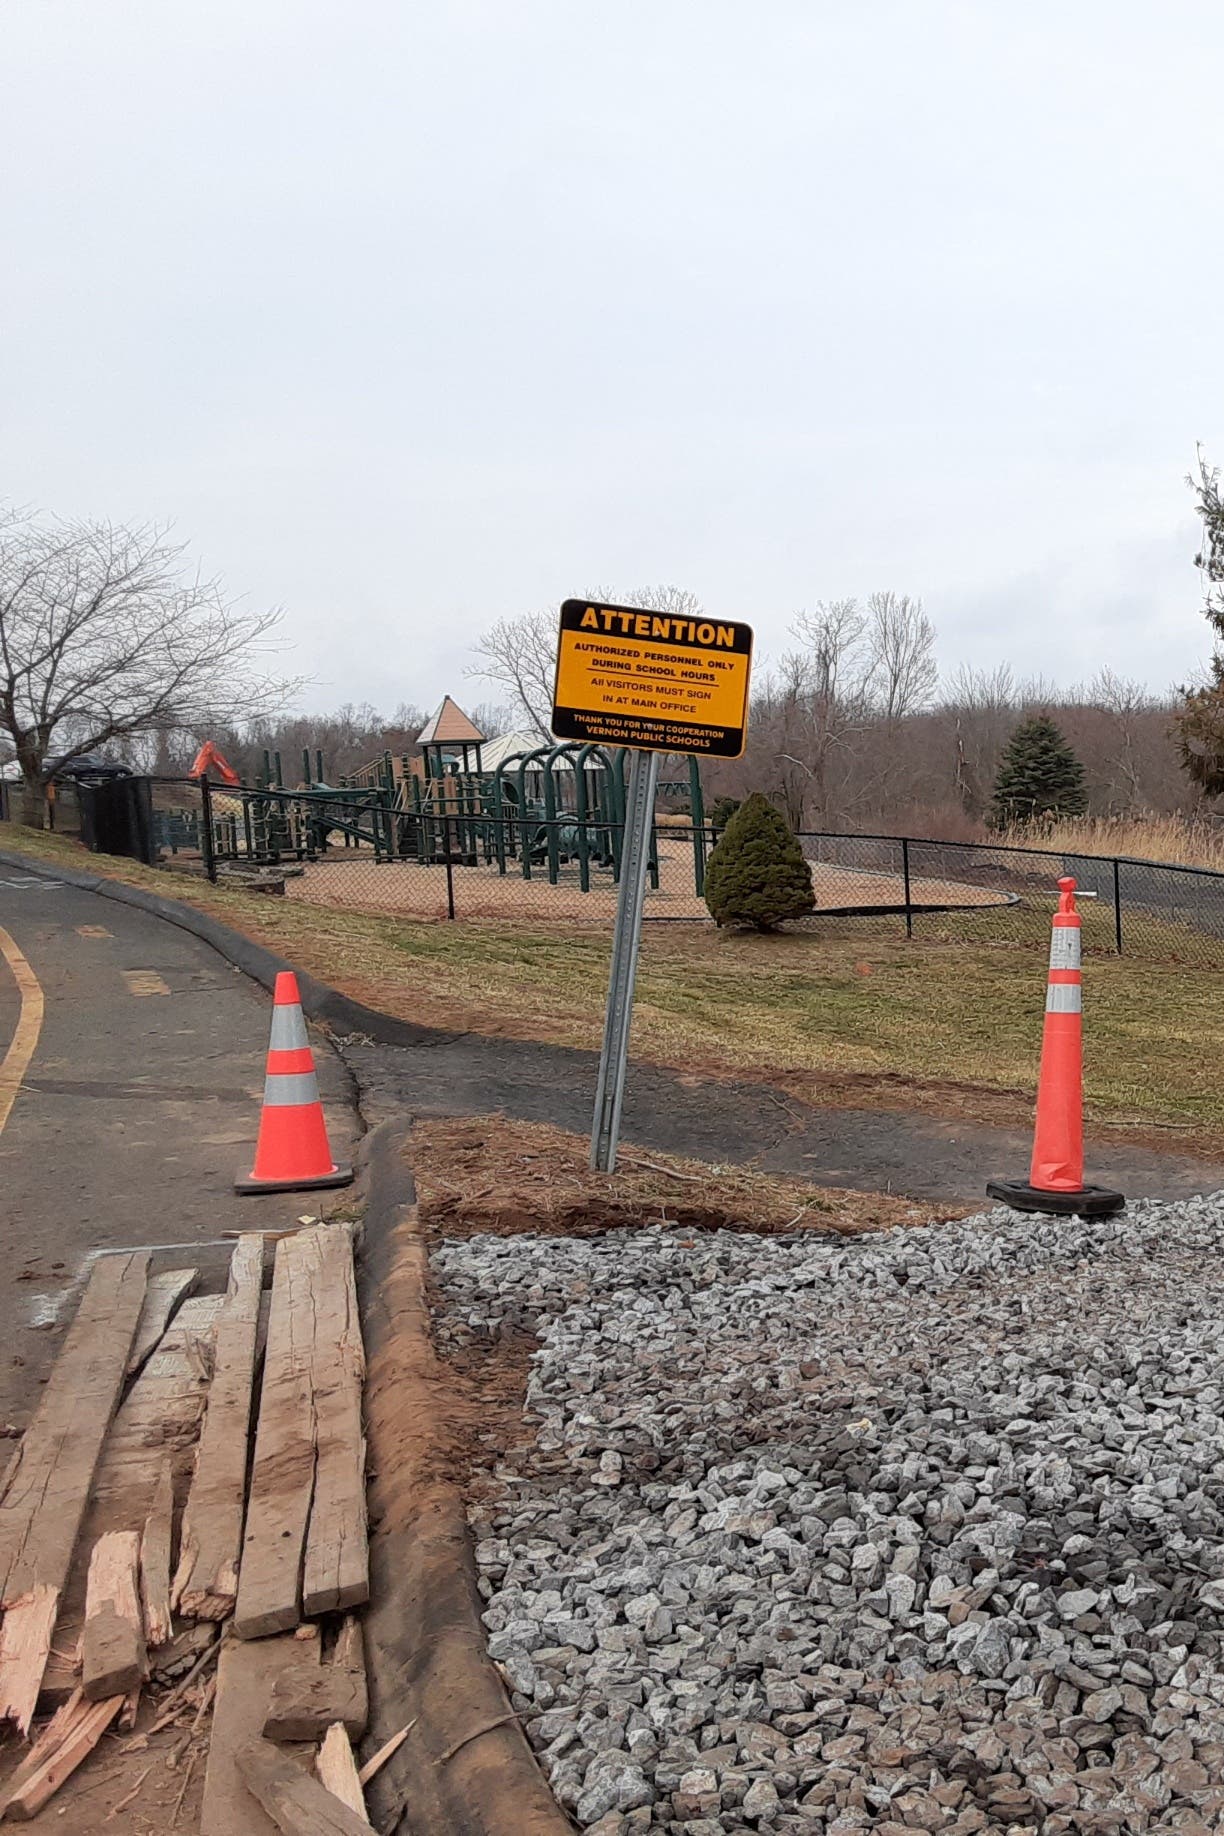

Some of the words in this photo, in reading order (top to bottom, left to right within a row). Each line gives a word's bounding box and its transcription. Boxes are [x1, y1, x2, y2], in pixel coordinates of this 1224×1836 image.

[580, 607, 735, 647] ATTENTION
[574, 642, 640, 659] AUTHORIZED
[644, 652, 704, 667] PERSONNEL
[707, 659, 735, 671] ONLY
[592, 658, 632, 671] DURING
[636, 664, 676, 677] SCHOOL
[681, 670, 716, 682] HOURS
[606, 679, 653, 693] VISITORS
[656, 686, 685, 697] MUST
[687, 690, 712, 700] SIGN
[602, 695, 614, 703] IN
[616, 696, 629, 705] AT
[631, 698, 657, 709] MAIN
[660, 701, 697, 713] OFFICE
[573, 713, 603, 724] THANK
[605, 717, 622, 726] YOU
[623, 719, 641, 729] FOR
[642, 722, 665, 732] YOUR
[666, 725, 725, 739] COOPERATION
[586, 725, 628, 738] VERNON
[630, 730, 664, 743] PUBLIC
[666, 735, 711, 748] SCHOOLS
